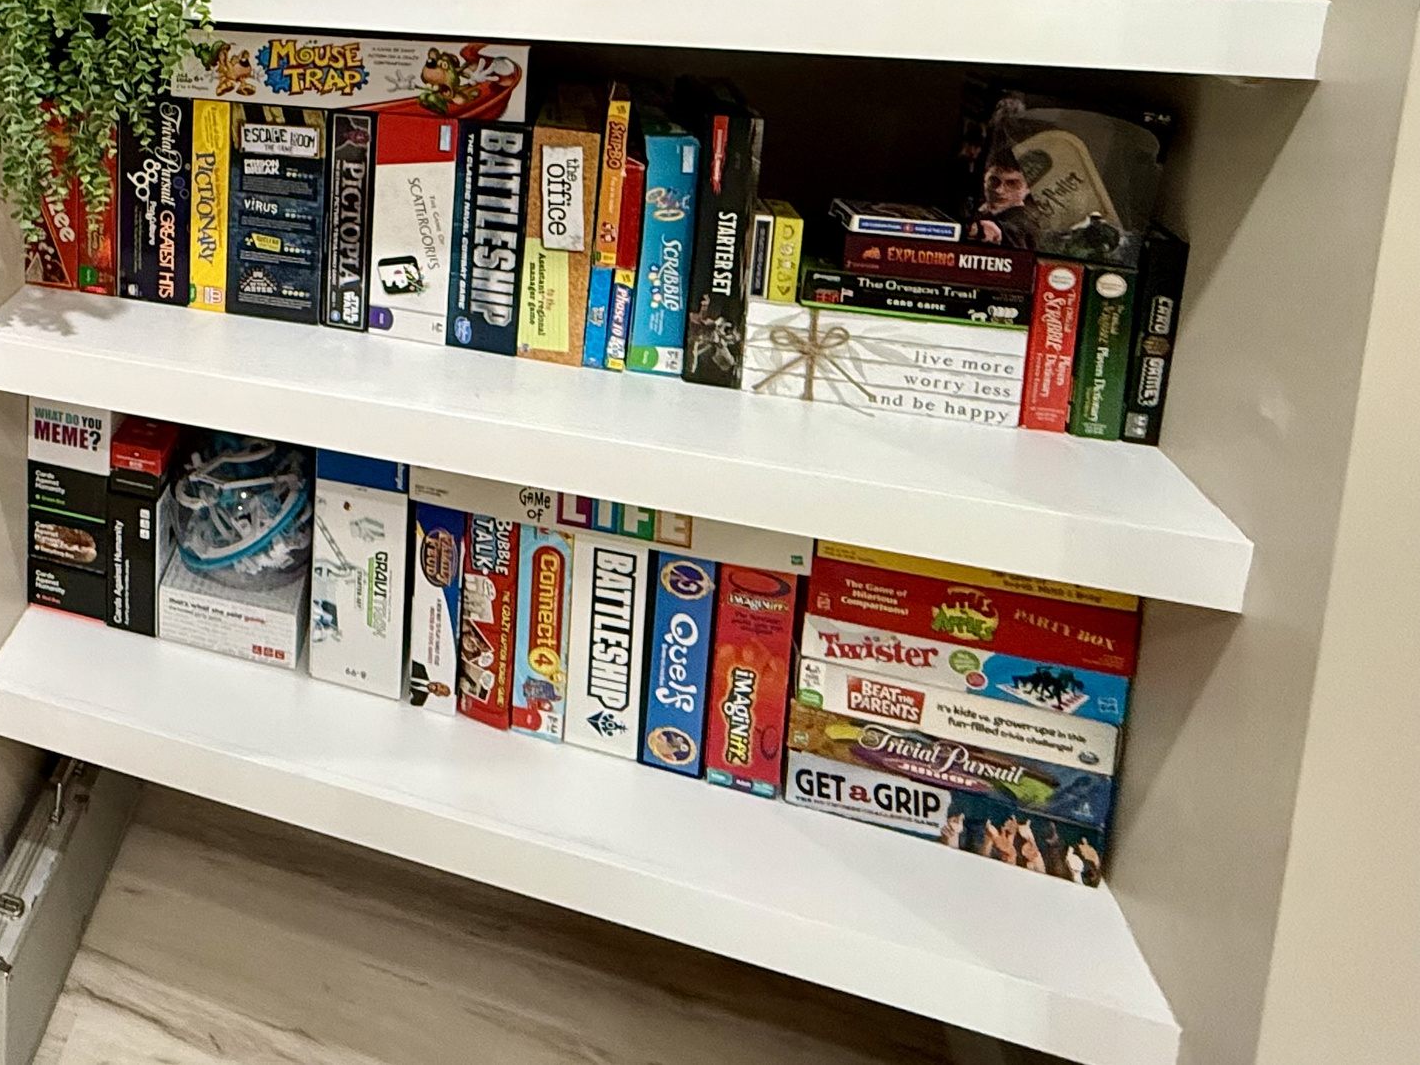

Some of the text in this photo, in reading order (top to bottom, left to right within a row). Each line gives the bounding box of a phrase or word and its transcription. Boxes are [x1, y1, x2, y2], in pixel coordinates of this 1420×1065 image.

[268, 38, 363, 70] MOUSE
[283, 67, 363, 96] TRAP
[244, 127, 316, 148] ESCAPE ROOM
[466, 133, 474, 154] THE
[463, 156, 473, 200] CLASSIC
[565, 157, 580, 182] the
[154, 101, 183, 299] Trivial Pursuit GREATEST HITS
[194, 150, 217, 265] PICTIONARY
[428, 195, 437, 209] THE
[546, 163, 572, 236] office
[338, 159, 366, 288] PICTOPIA
[432, 210, 443, 234] GAME
[462, 201, 471, 235] NAVAL
[469, 128, 524, 328] BATTLESHIP
[459, 237, 469, 279] COMBAT
[711, 211, 738, 296] STARTER SET
[886, 246, 1013, 273] EXPLODING KITTENS
[457, 280, 466, 311] GAME
[527, 262, 537, 326] manager game
[536, 253, 547, 337] Assistant regional
[856, 276, 978, 300] The Oregon Trail
[886, 297, 946, 311] CARD GAME
[342, 291, 353, 323] WARS
[350, 294, 360, 324] STAR
[614, 286, 629, 323] Phase
[1041, 291, 1067, 353] SCRABBLE
[913, 350, 1015, 376] live more
[1040, 353, 1058, 398] Dictionary
[1056, 354, 1071, 386] Players
[903, 374, 1012, 399] worry less
[1088, 346, 1110, 423] Players Dictionary
[33, 406, 102, 431] WHAT DO YOU
[868, 394, 1010, 425] and be happy
[33, 419, 102, 452] MEME?
[35, 469, 55, 480] Cards
[35, 476, 60, 487] Against
[35, 482, 66, 495] Humanity
[472, 518, 494, 572] TALK
[495, 519, 513, 576] BUBBLE
[35, 569, 55, 580] Cards
[35, 576, 60, 587] Against
[113, 519, 125, 624] Cards Against Humanity
[35, 582, 66, 595] Humanity
[845, 578, 908, 598] The Game of
[851, 589, 898, 605] Hilarious
[191, 603, 210, 611] what
[211, 607, 224, 616] she
[499, 603, 511, 633] CRAZY
[840, 595, 909, 616] Comparisons!
[588, 547, 637, 713] BATTLESHIP
[1013, 607, 1071, 637] PARTY
[1076, 629, 1116, 652] BOX
[535, 652, 553, 667] 4
[655, 612, 699, 714] Quelf
[818, 631, 939, 668] Twister
[849, 690, 920, 722] PARENTS
[860, 679, 915, 707] BEAT THE
[947, 717, 999, 736] fun-filled
[1026, 736, 1074, 753] challenge!
[953, 705, 977, 720] kids
[993, 715, 1057, 737] grown-ups
[1068, 731, 1087, 744] this
[857, 723, 1025, 785] Trivial Pursuit
[795, 768, 846, 802] GET
[848, 784, 872, 804] a
[873, 783, 942, 819] GRIP
